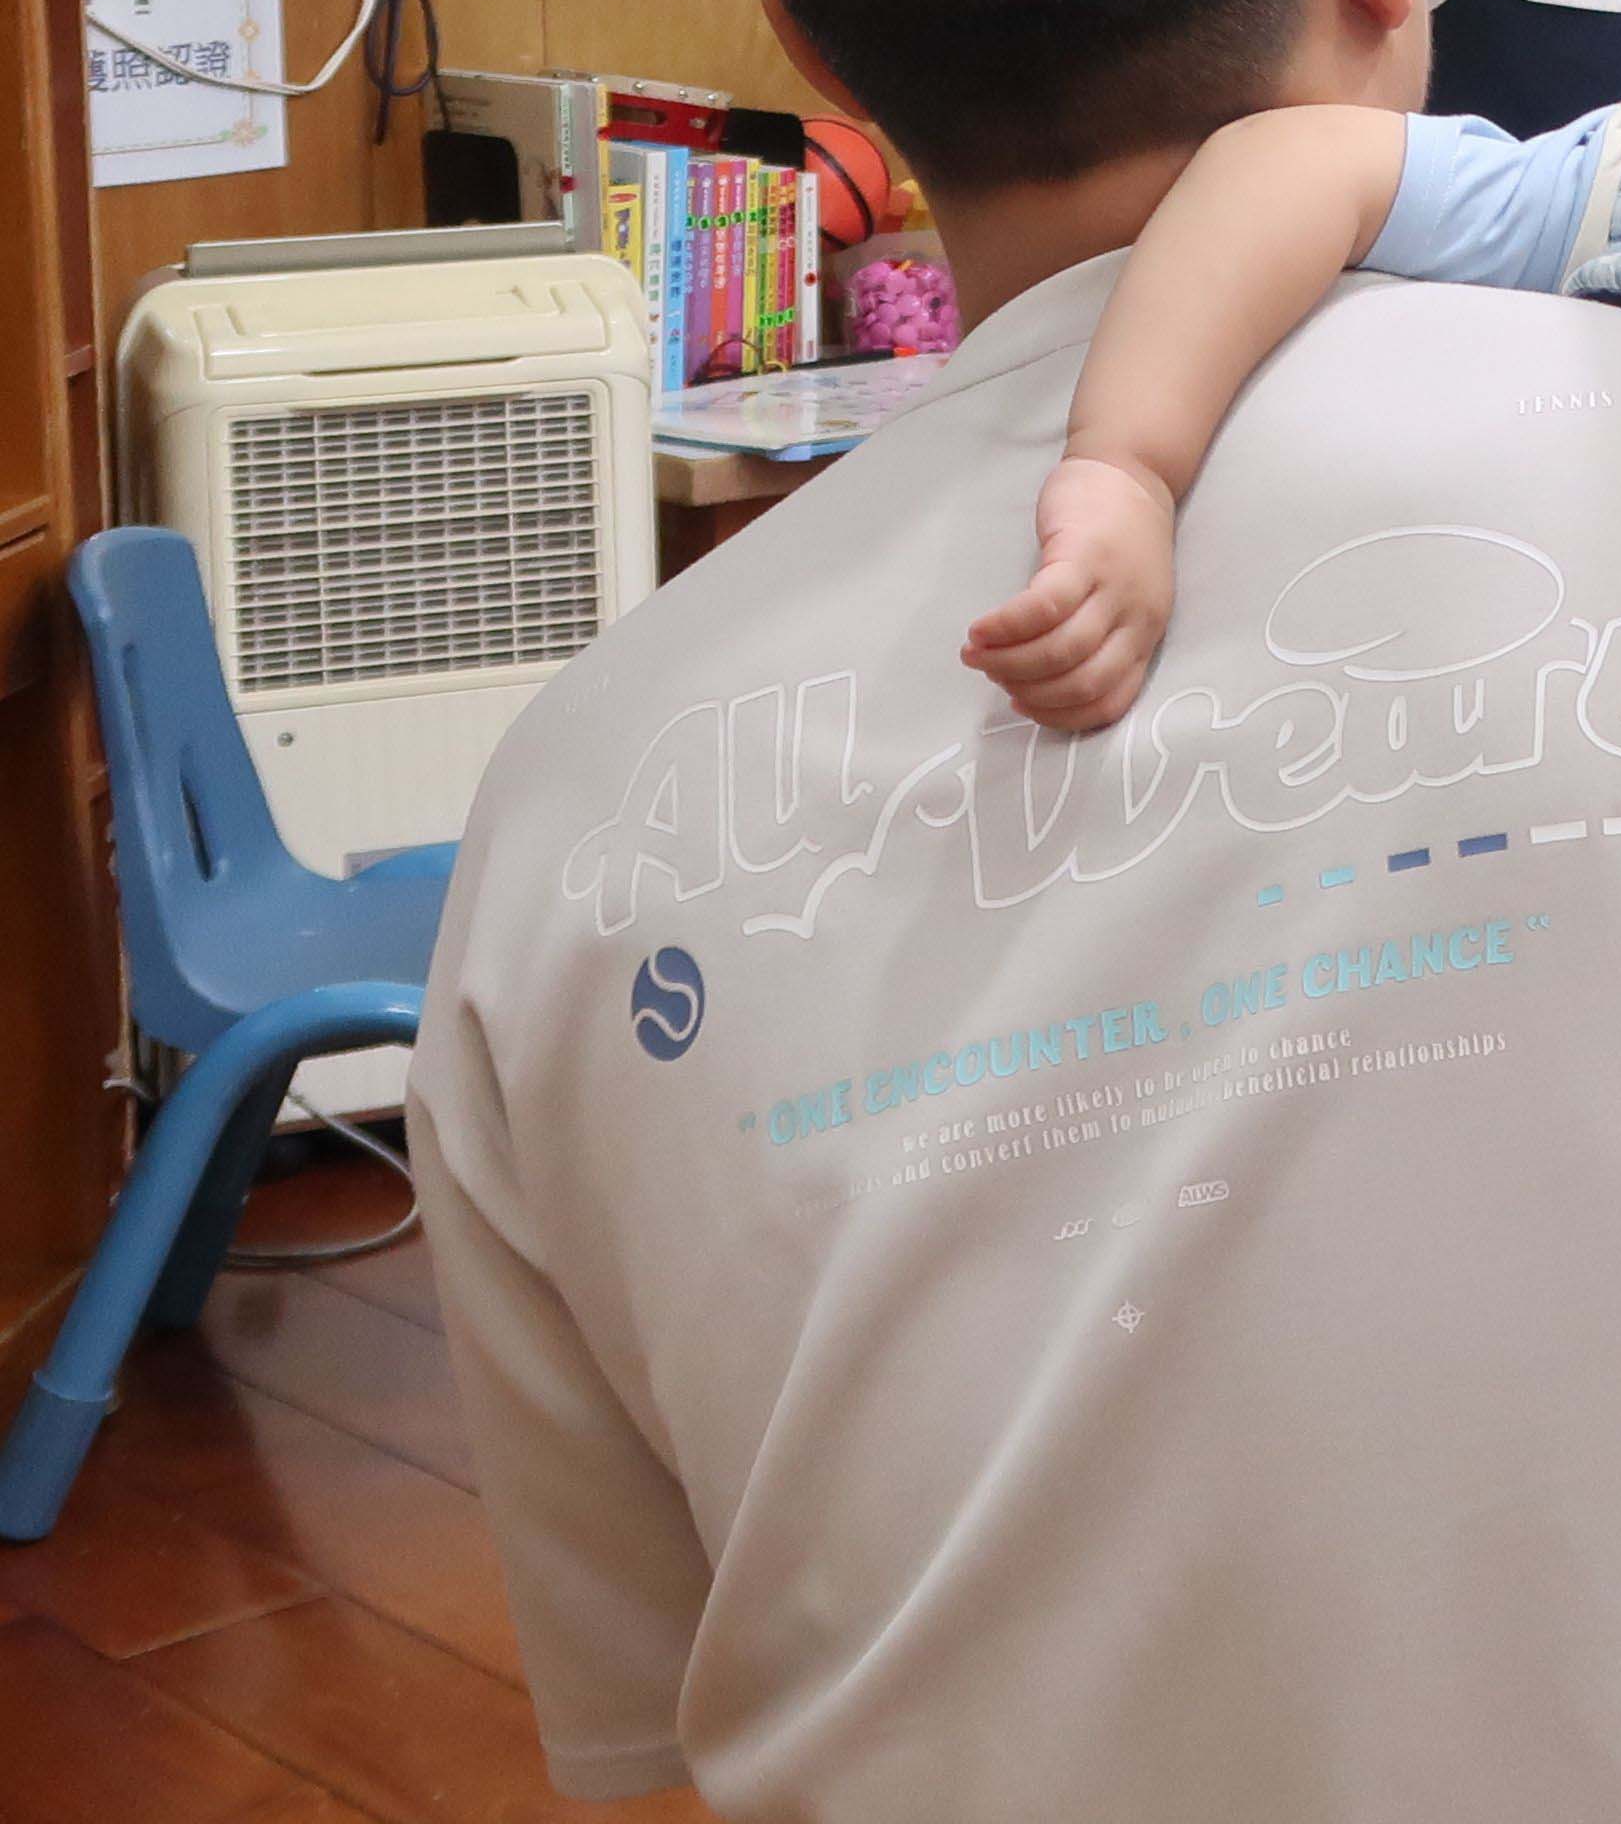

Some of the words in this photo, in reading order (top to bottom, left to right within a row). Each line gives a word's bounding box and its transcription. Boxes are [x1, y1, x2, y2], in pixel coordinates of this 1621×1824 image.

[1516, 388, 1614, 416] TENNIS
[766, 1078, 854, 1146] ONE
[864, 999, 1168, 1115] ENCOUNTER
[1201, 962, 1290, 1028] ONE
[1302, 919, 1517, 1000] CHANCE
[938, 1118, 976, 1146] are
[986, 1107, 1050, 1136] more
[1055, 1082, 1125, 1120] likely
[1134, 1072, 1156, 1100] to
[1268, 1025, 1353, 1061] chance
[941, 1136, 1034, 1174] convert
[1042, 1119, 1102, 1151] them
[1110, 1110, 1132, 1136] to
[1221, 1057, 1341, 1102] beneficial
[1351, 1031, 1508, 1076] relationships
